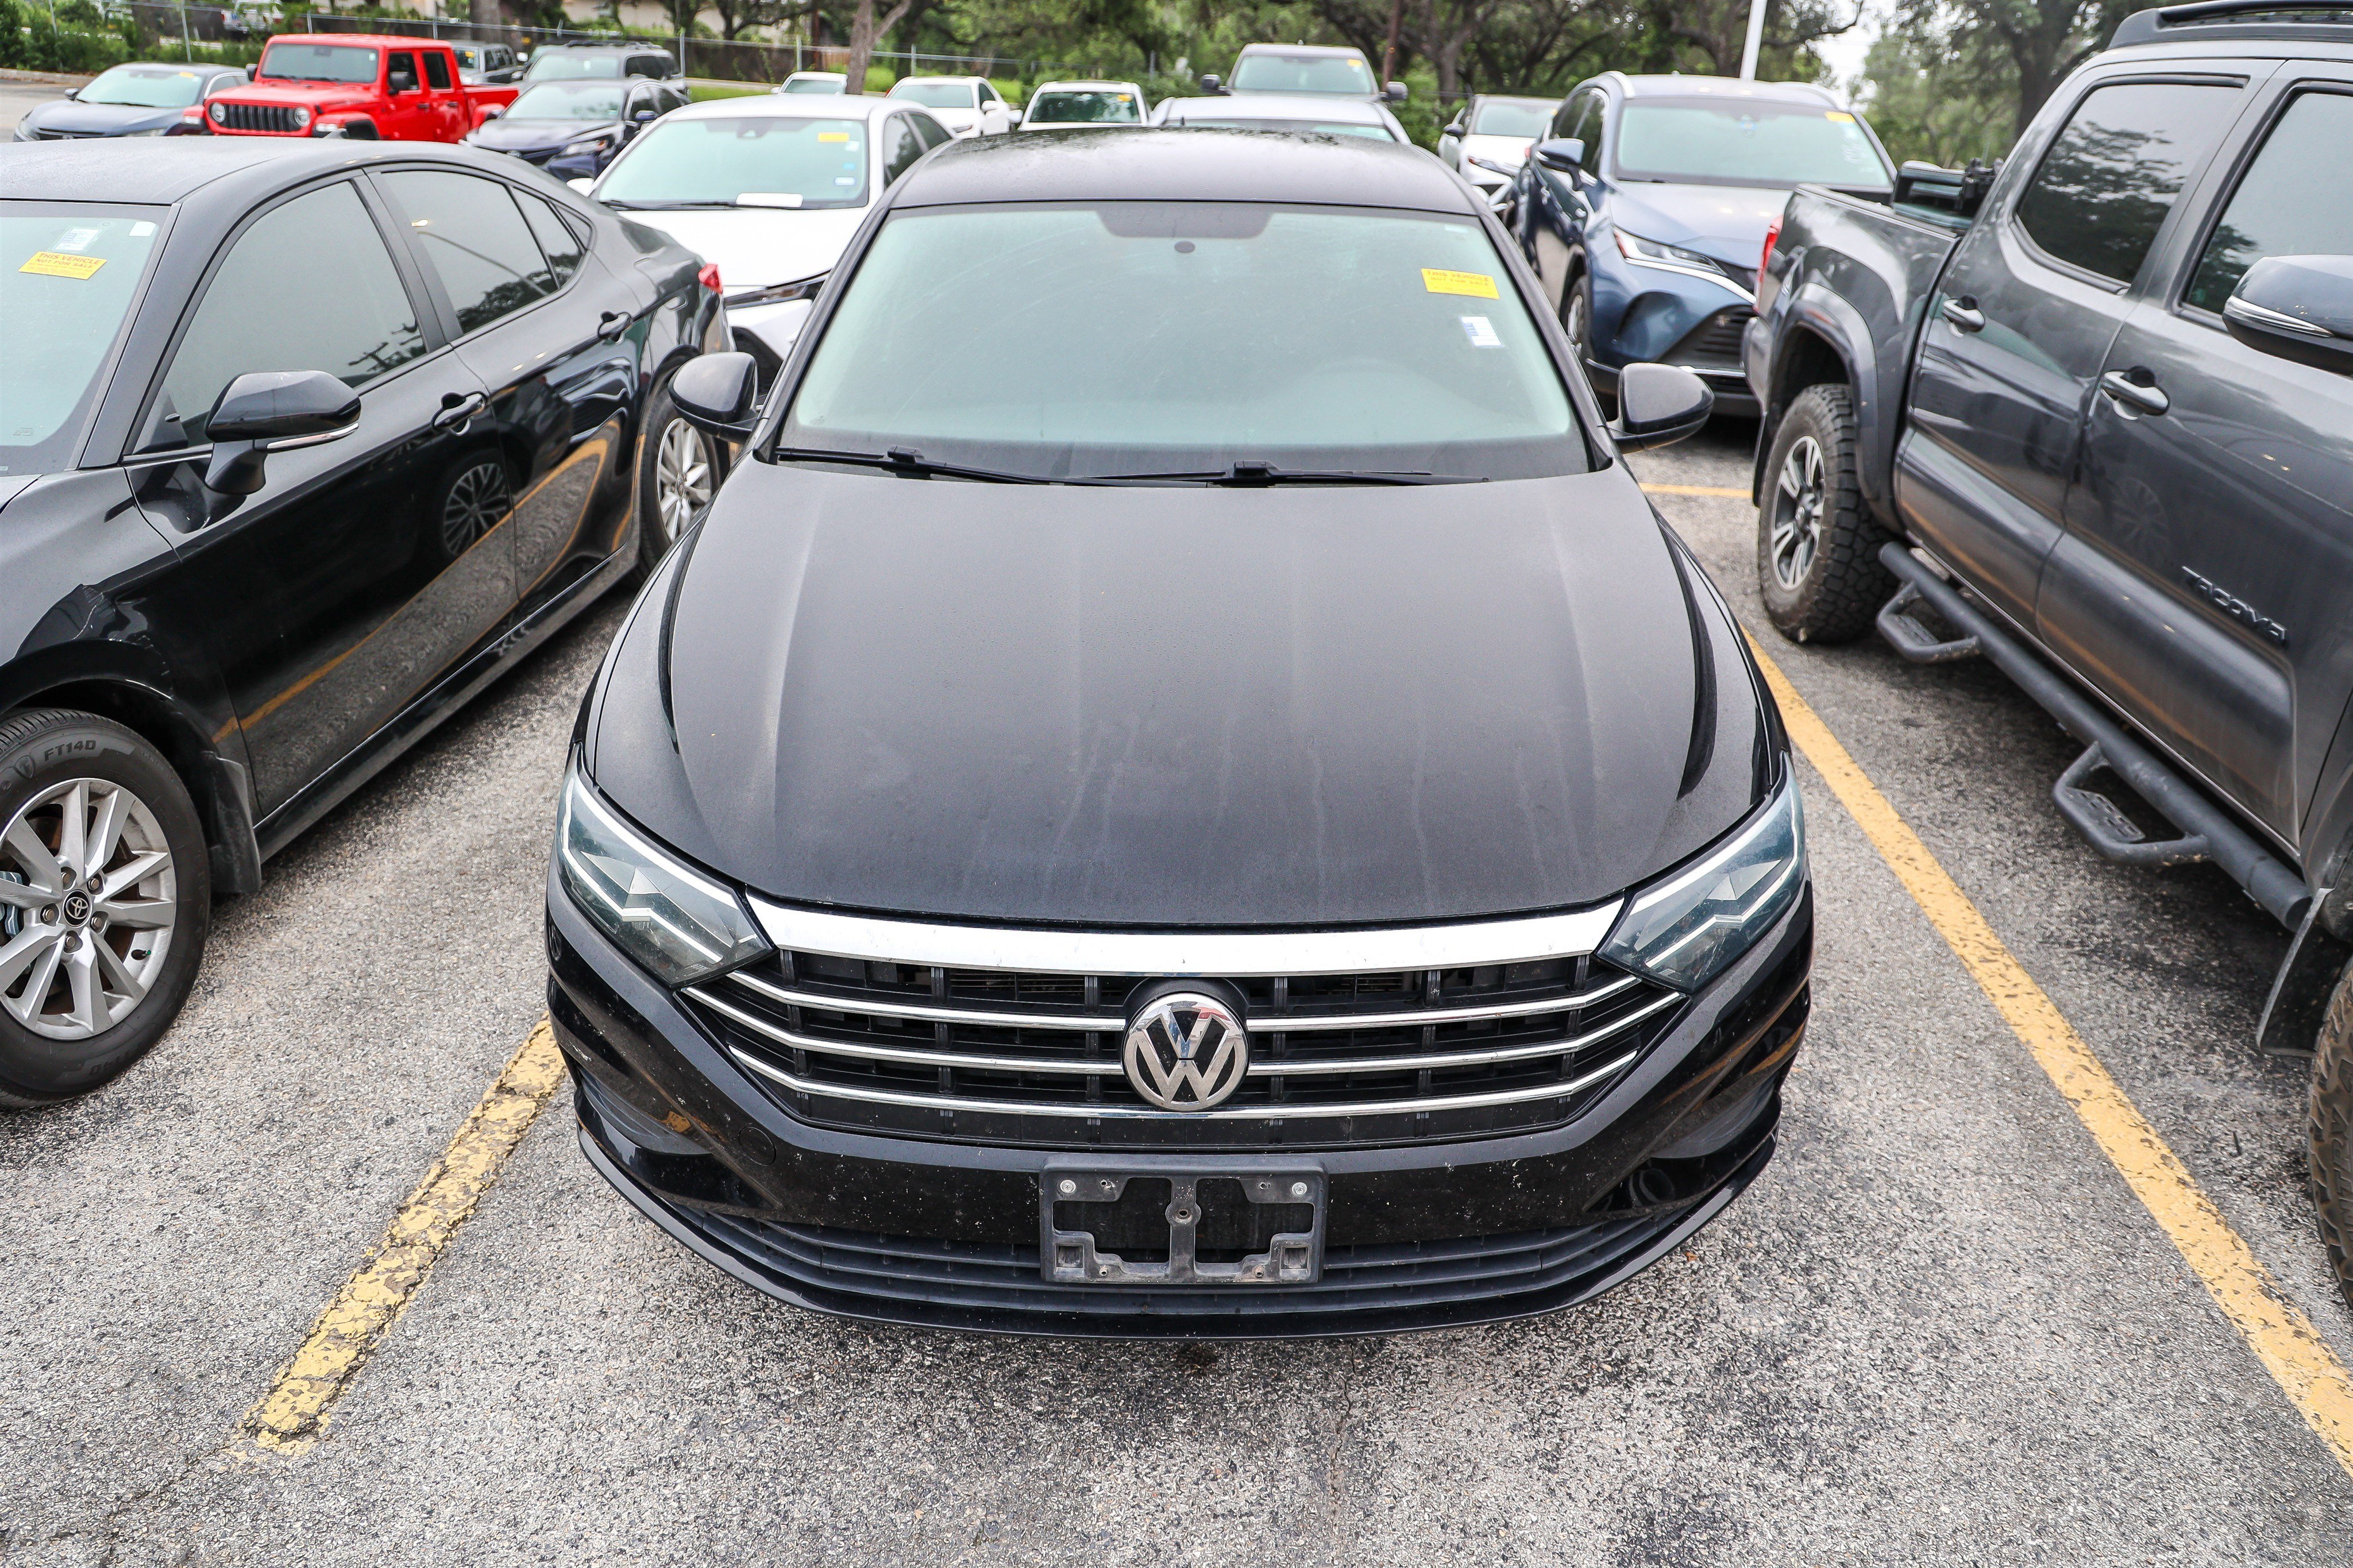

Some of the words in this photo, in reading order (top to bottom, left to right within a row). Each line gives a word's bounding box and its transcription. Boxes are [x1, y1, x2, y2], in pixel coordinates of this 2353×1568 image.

[62, 256, 102, 265] VEHICLE
[1451, 272, 1490, 281] VEHICLE
[2181, 565, 2289, 644] TACOMA
[44, 739, 97, 762] FT140
